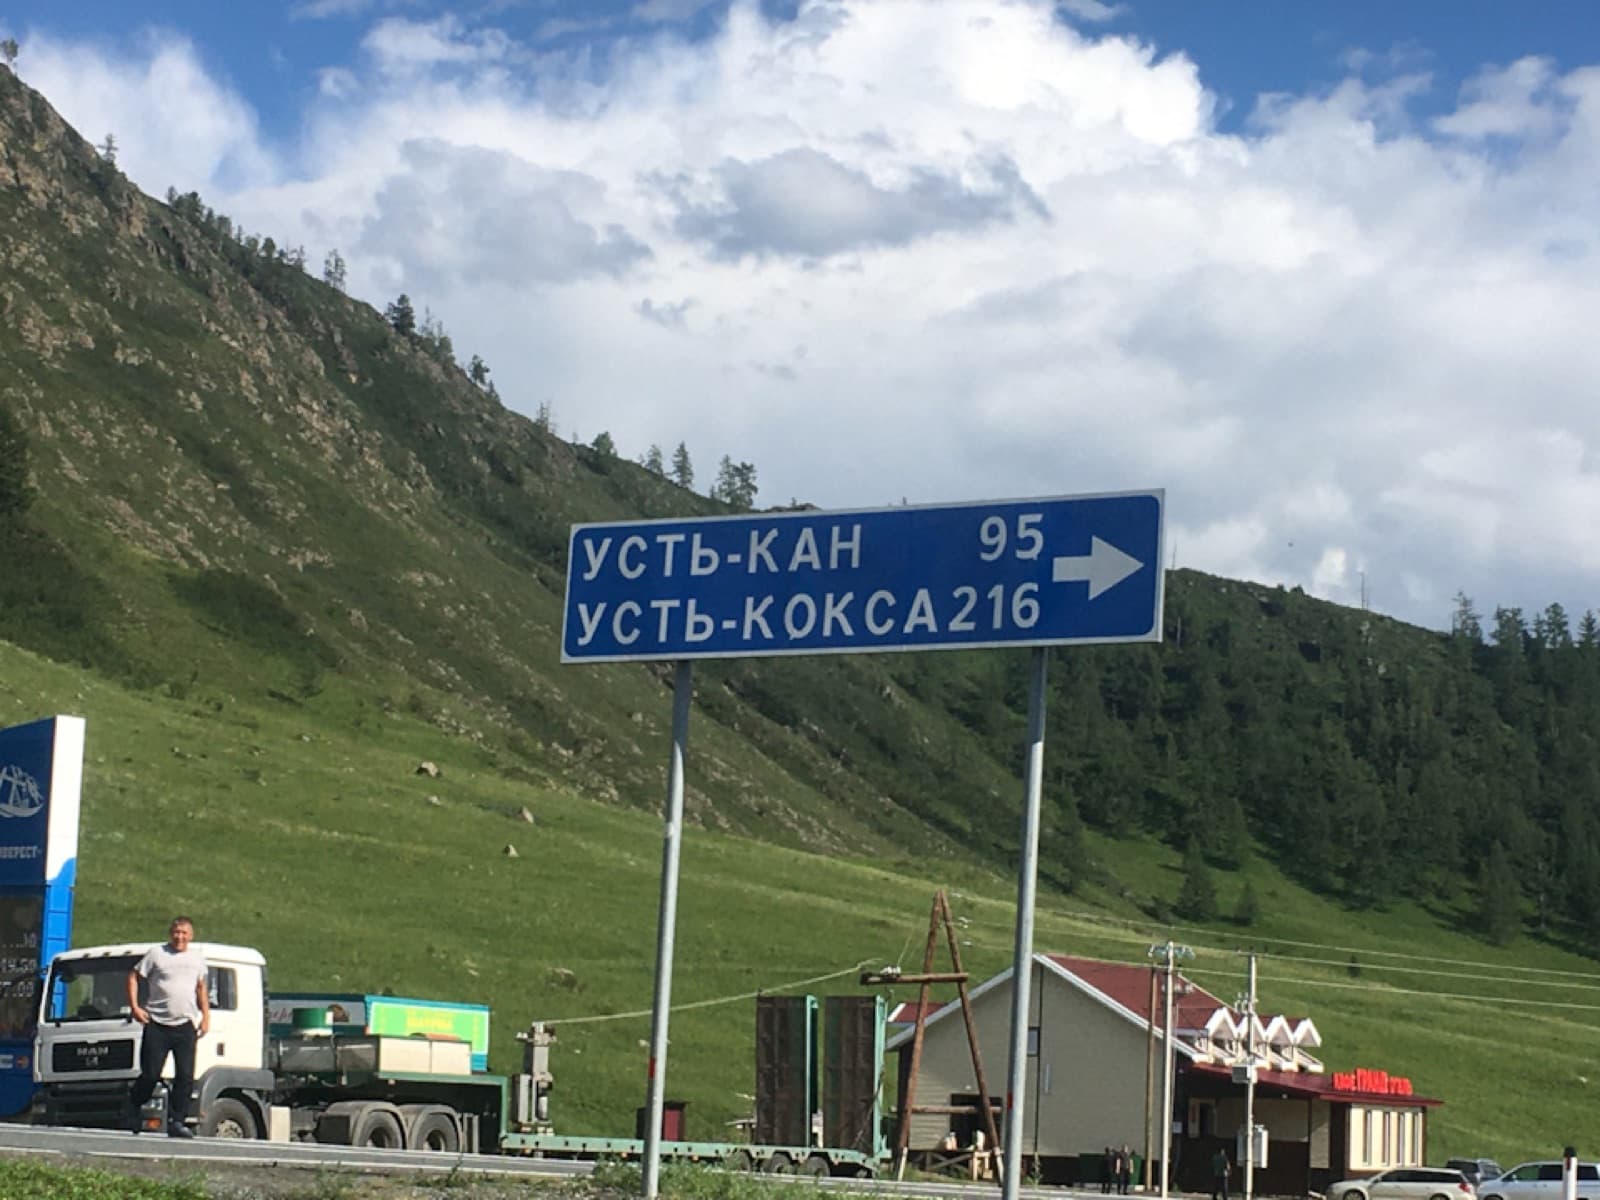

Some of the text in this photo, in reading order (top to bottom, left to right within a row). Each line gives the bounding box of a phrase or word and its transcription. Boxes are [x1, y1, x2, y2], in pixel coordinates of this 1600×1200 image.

[583, 513, 1045, 581] УСТЬ-КАН 95
[577, 582, 1042, 646] УСТЬ-КОКСА 216
